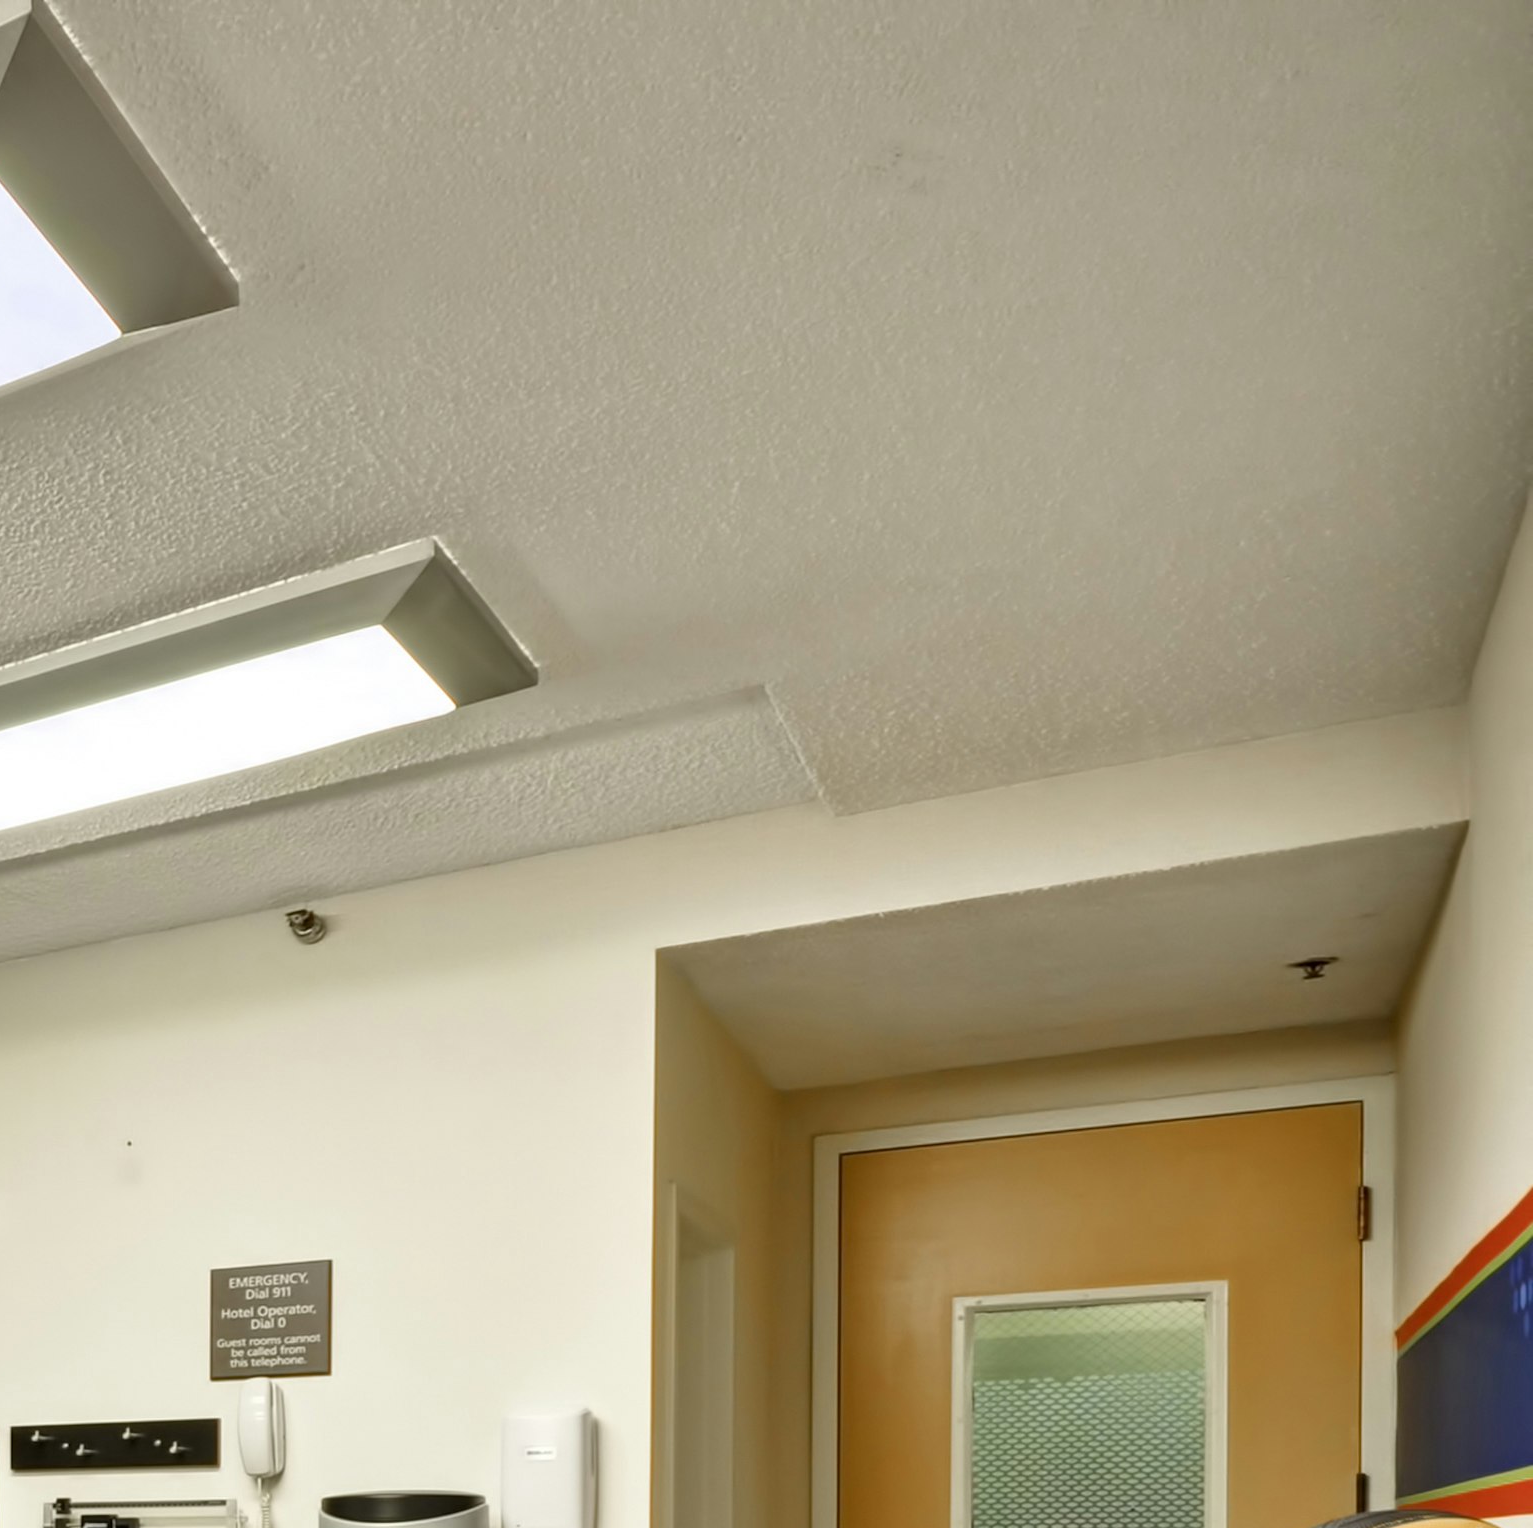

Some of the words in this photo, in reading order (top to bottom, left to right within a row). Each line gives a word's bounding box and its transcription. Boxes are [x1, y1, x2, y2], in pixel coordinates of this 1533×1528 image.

[228, 1272, 309, 1289] EMERGENCY,
[245, 1288, 269, 1300] Dial
[272, 1286, 291, 1298] 911
[221, 1307, 254, 1319] Hotel
[257, 1304, 317, 1318] Operator,
[250, 1319, 274, 1330] Dial
[277, 1317, 287, 1328] 0
[216, 1338, 246, 1348] Guest
[249, 1337, 282, 1346] rooms
[284, 1334, 321, 1344] cannot
[231, 1348, 245, 1357] be
[247, 1346, 277, 1356] called
[280, 1345, 306, 1355] from
[230, 1358, 249, 1368] this
[251, 1355, 308, 1367] telephone.
